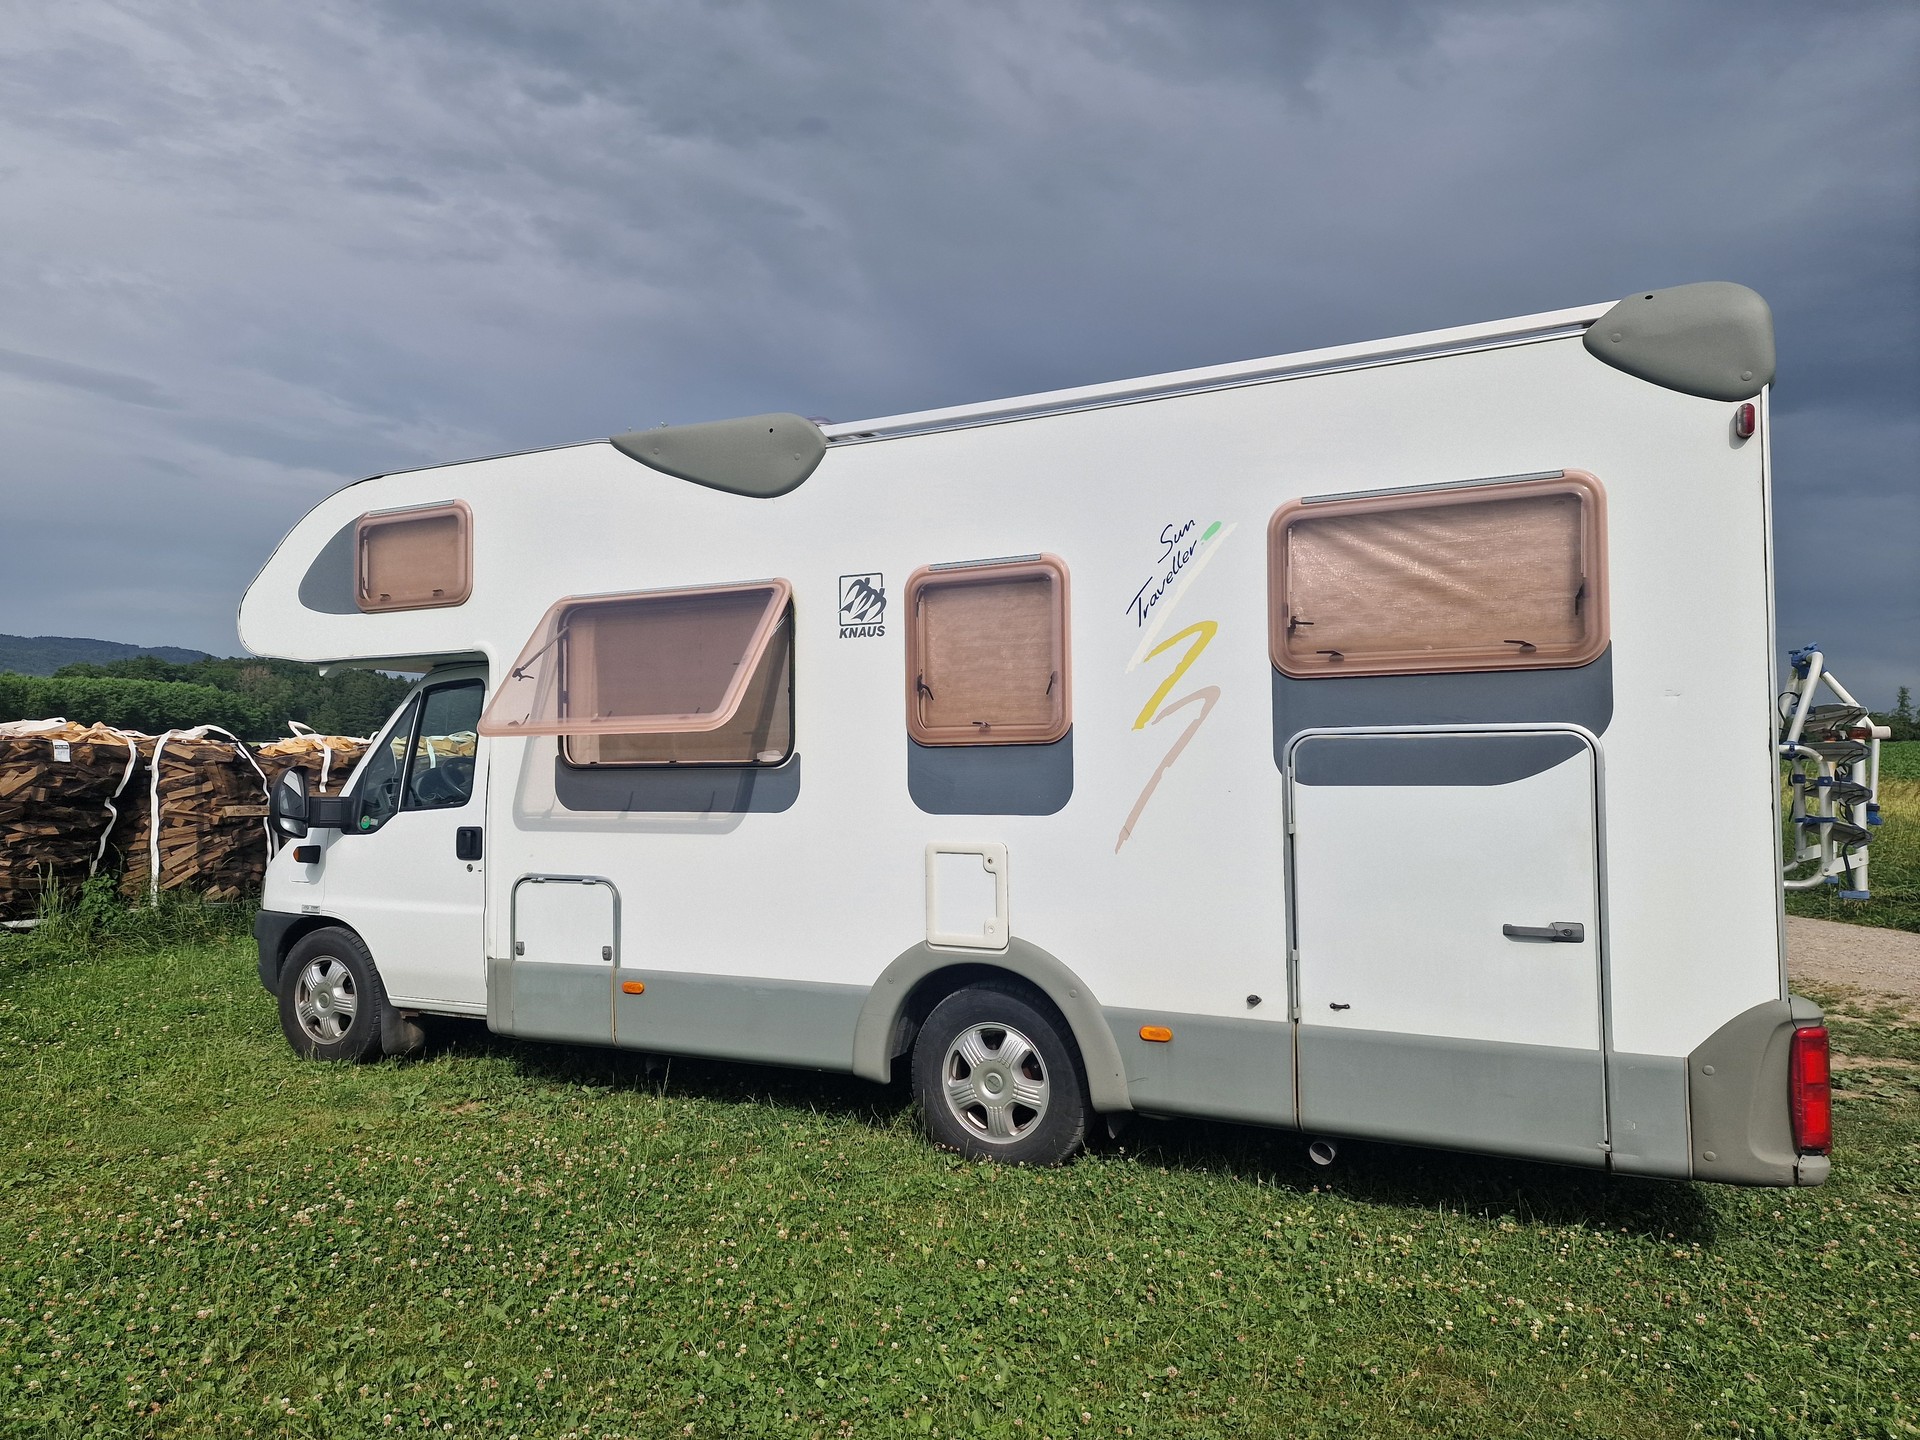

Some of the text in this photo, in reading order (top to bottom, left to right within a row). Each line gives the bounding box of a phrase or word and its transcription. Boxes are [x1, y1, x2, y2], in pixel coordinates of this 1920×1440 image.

[1157, 519, 1196, 564] Sun
[1125, 539, 1198, 628] Traveller
[838, 625, 886, 639] KNAUS
